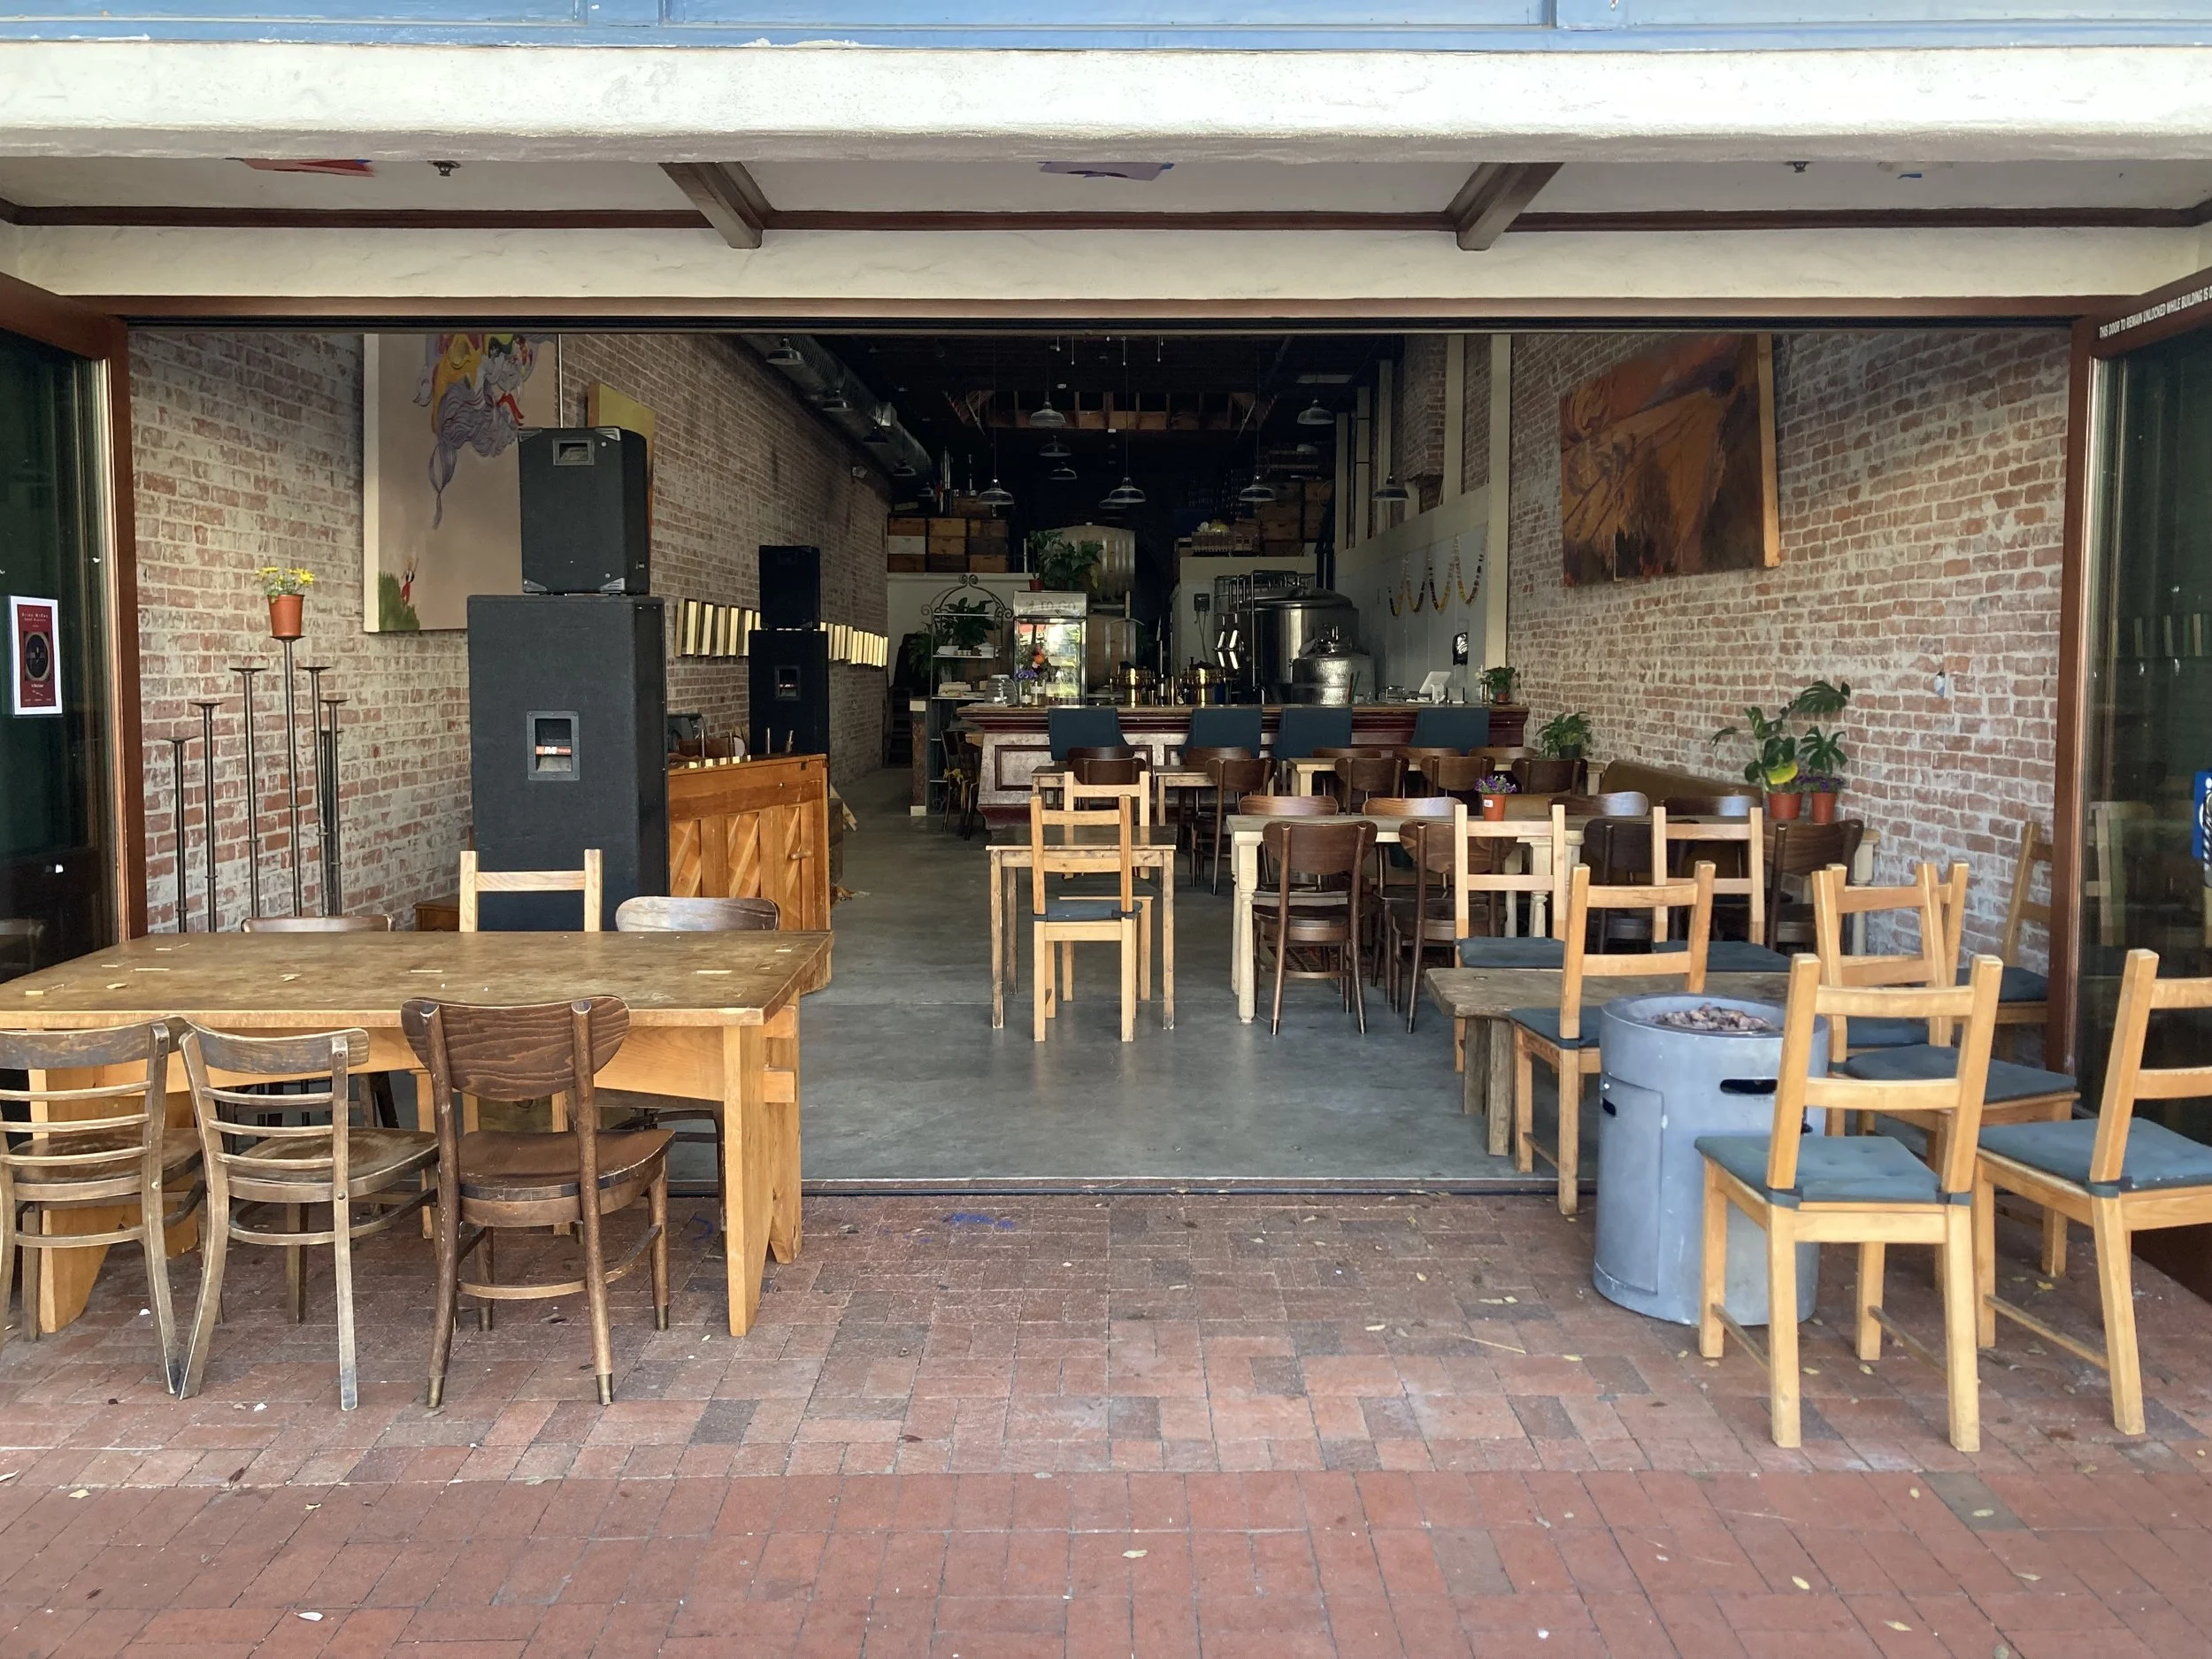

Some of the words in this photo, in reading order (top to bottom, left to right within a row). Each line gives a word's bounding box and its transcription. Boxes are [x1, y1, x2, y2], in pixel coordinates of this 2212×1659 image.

[2100, 325, 2108, 339] THIS
[2108, 320, 2120, 336] DOOR
[2120, 318, 2126, 332] TO
[2126, 312, 2143, 329] REMAIN
[2143, 303, 2166, 323] UNLOCKED
[2166, 297, 2181, 314] WHILE
[2181, 288, 2203, 309] BUILDING
